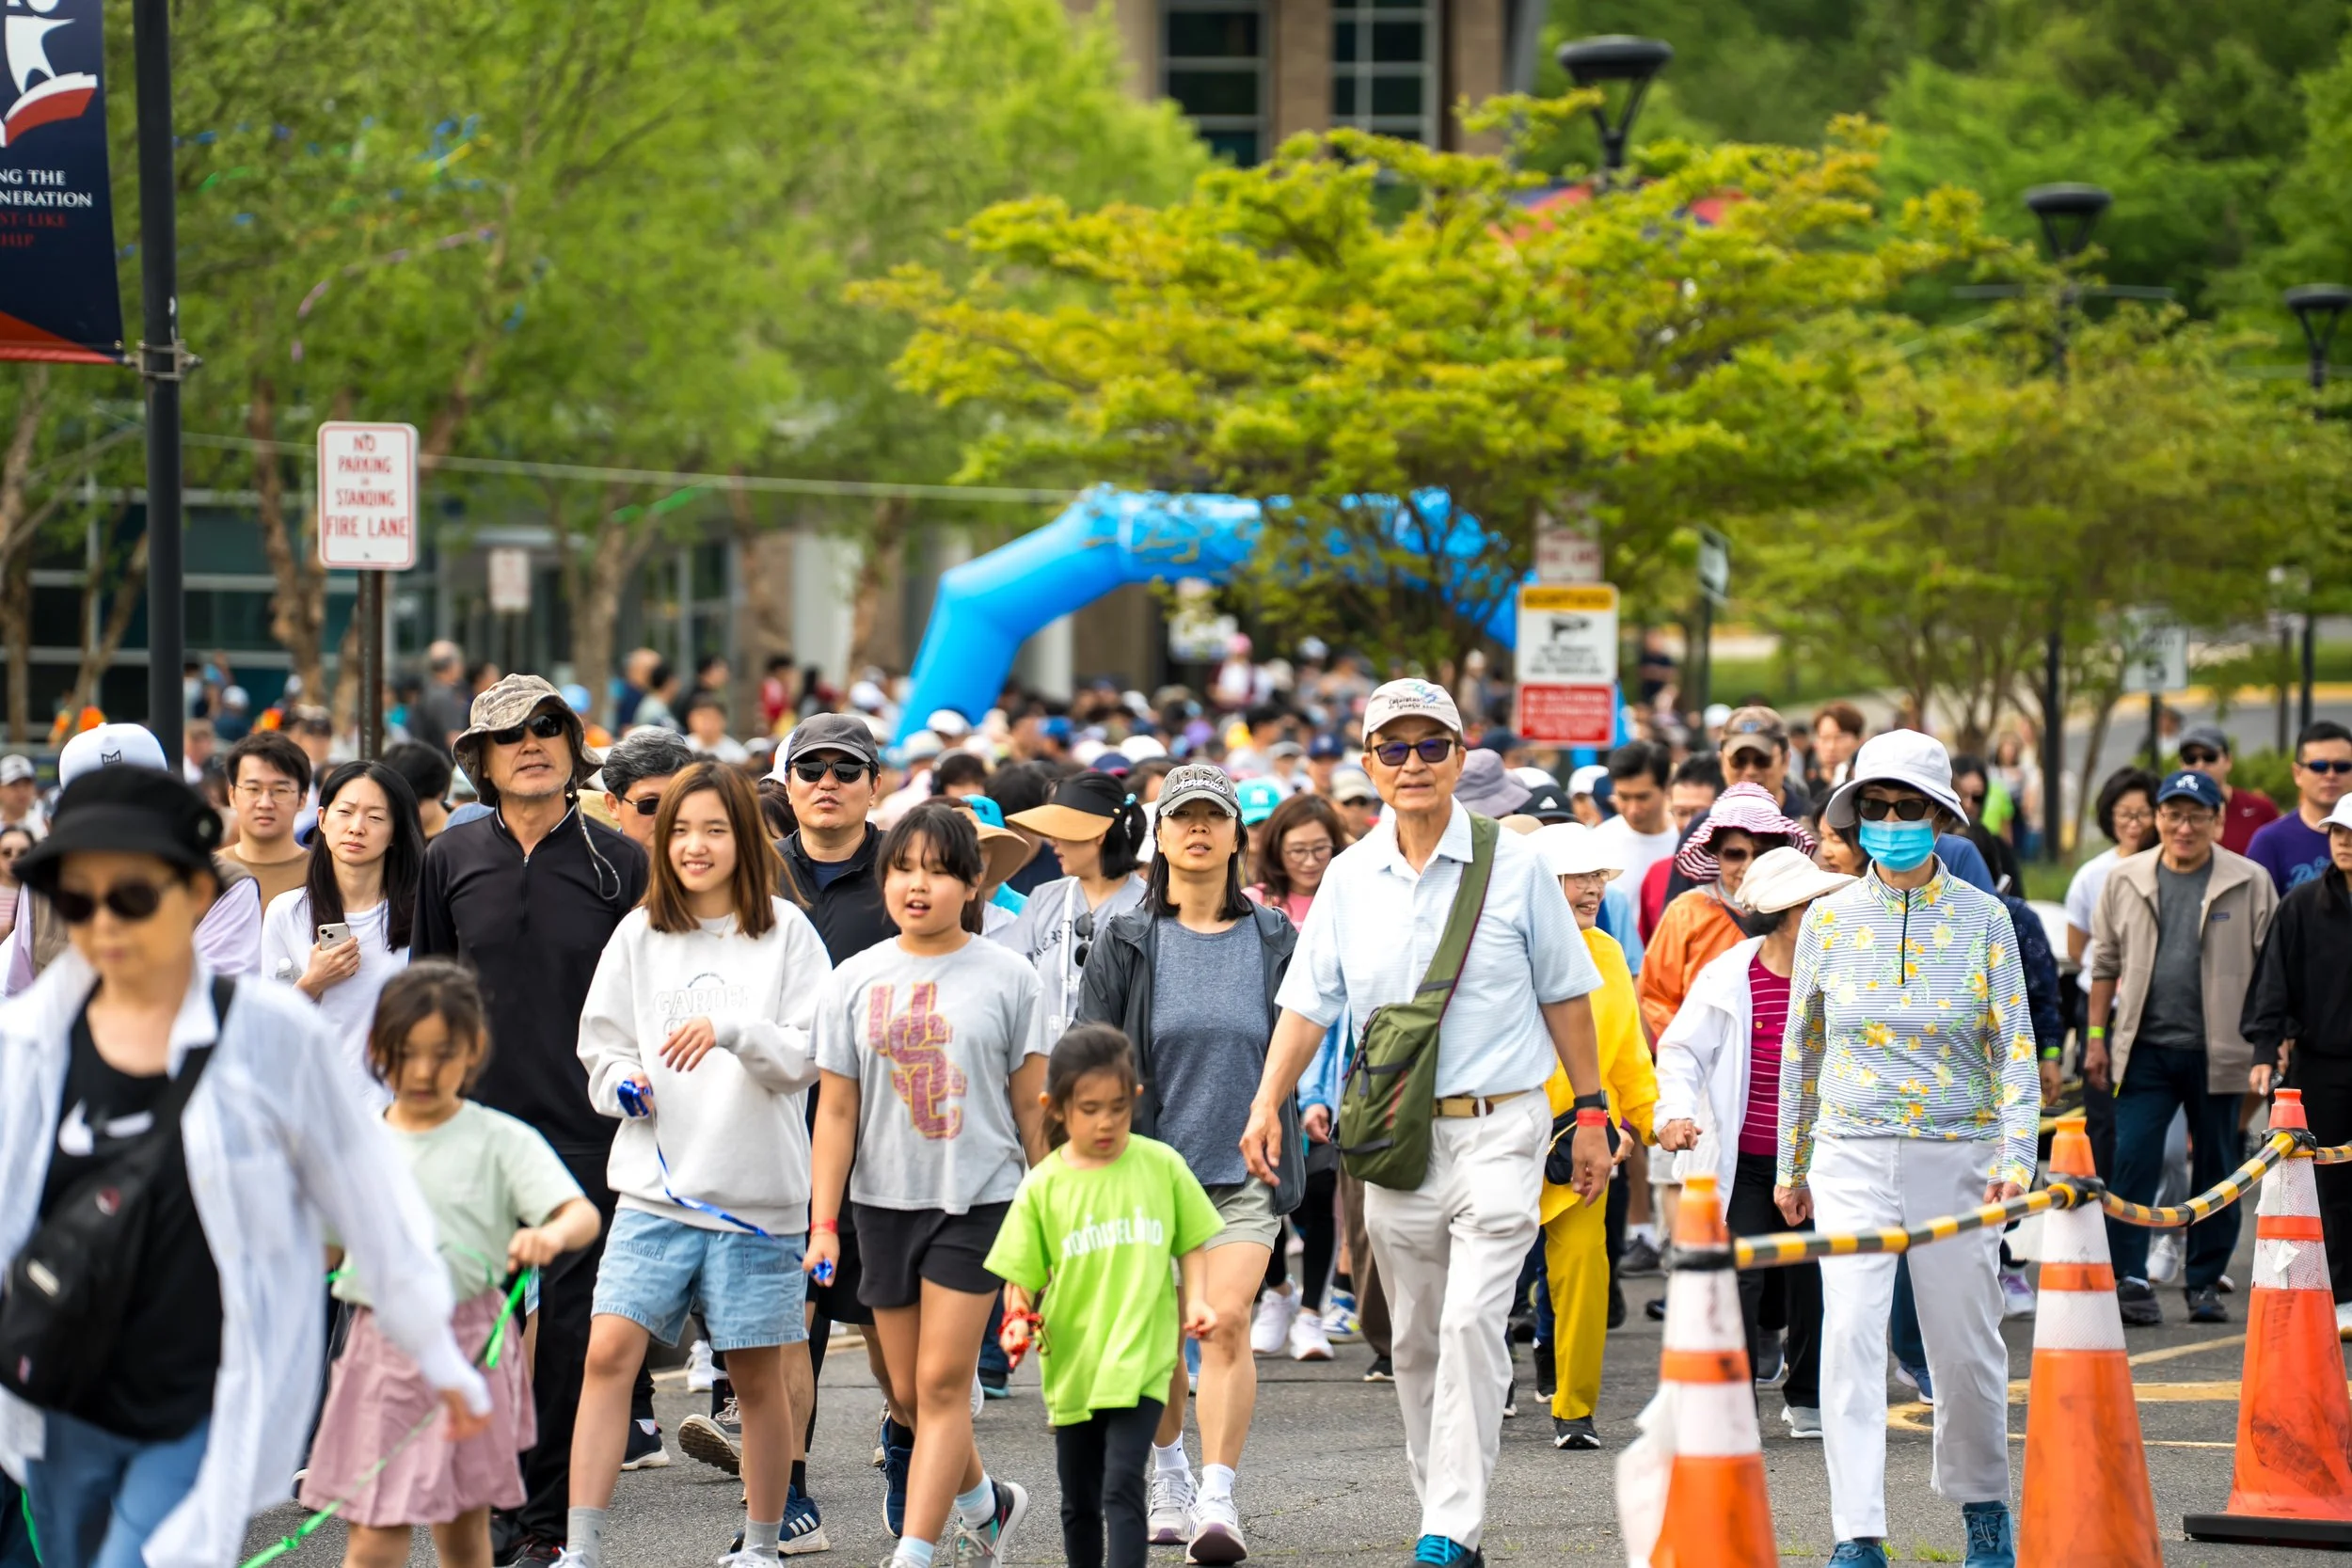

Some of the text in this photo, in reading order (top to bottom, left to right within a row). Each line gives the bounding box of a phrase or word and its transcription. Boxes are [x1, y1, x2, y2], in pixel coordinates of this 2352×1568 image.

[26, 168, 67, 186] THE
[0, 189, 93, 208] NERATION
[354, 436, 376, 452] NO
[338, 455, 392, 475] PARKING
[336, 488, 396, 508] STANDING
[326, 515, 409, 539] FIRE LANE
[1171, 777, 1230, 796] America
